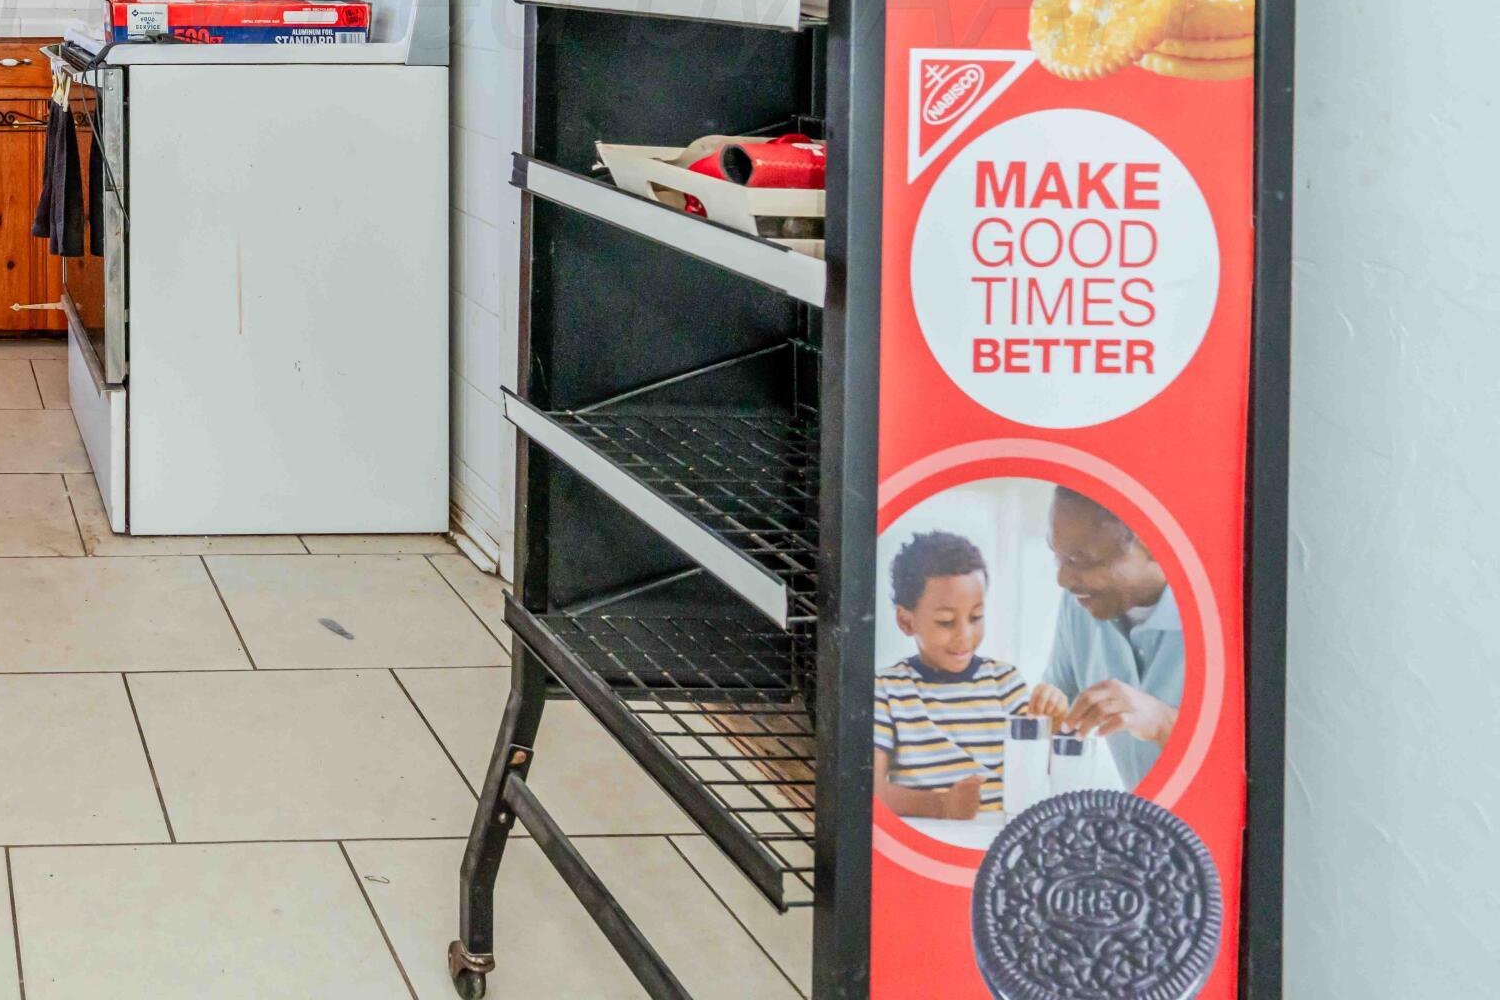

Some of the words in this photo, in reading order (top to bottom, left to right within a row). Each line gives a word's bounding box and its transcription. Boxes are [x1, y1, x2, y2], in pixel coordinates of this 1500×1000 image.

[291, 28, 322, 36] ALUMINUM
[322, 28, 334, 36] FOIL
[928, 69, 979, 119] NABISCO
[975, 161, 1161, 210] MAKE
[972, 217, 1158, 269] GOOD
[971, 276, 1156, 327] TIMES
[972, 338, 1155, 375] BETTER
[1050, 884, 1140, 920] OREO
